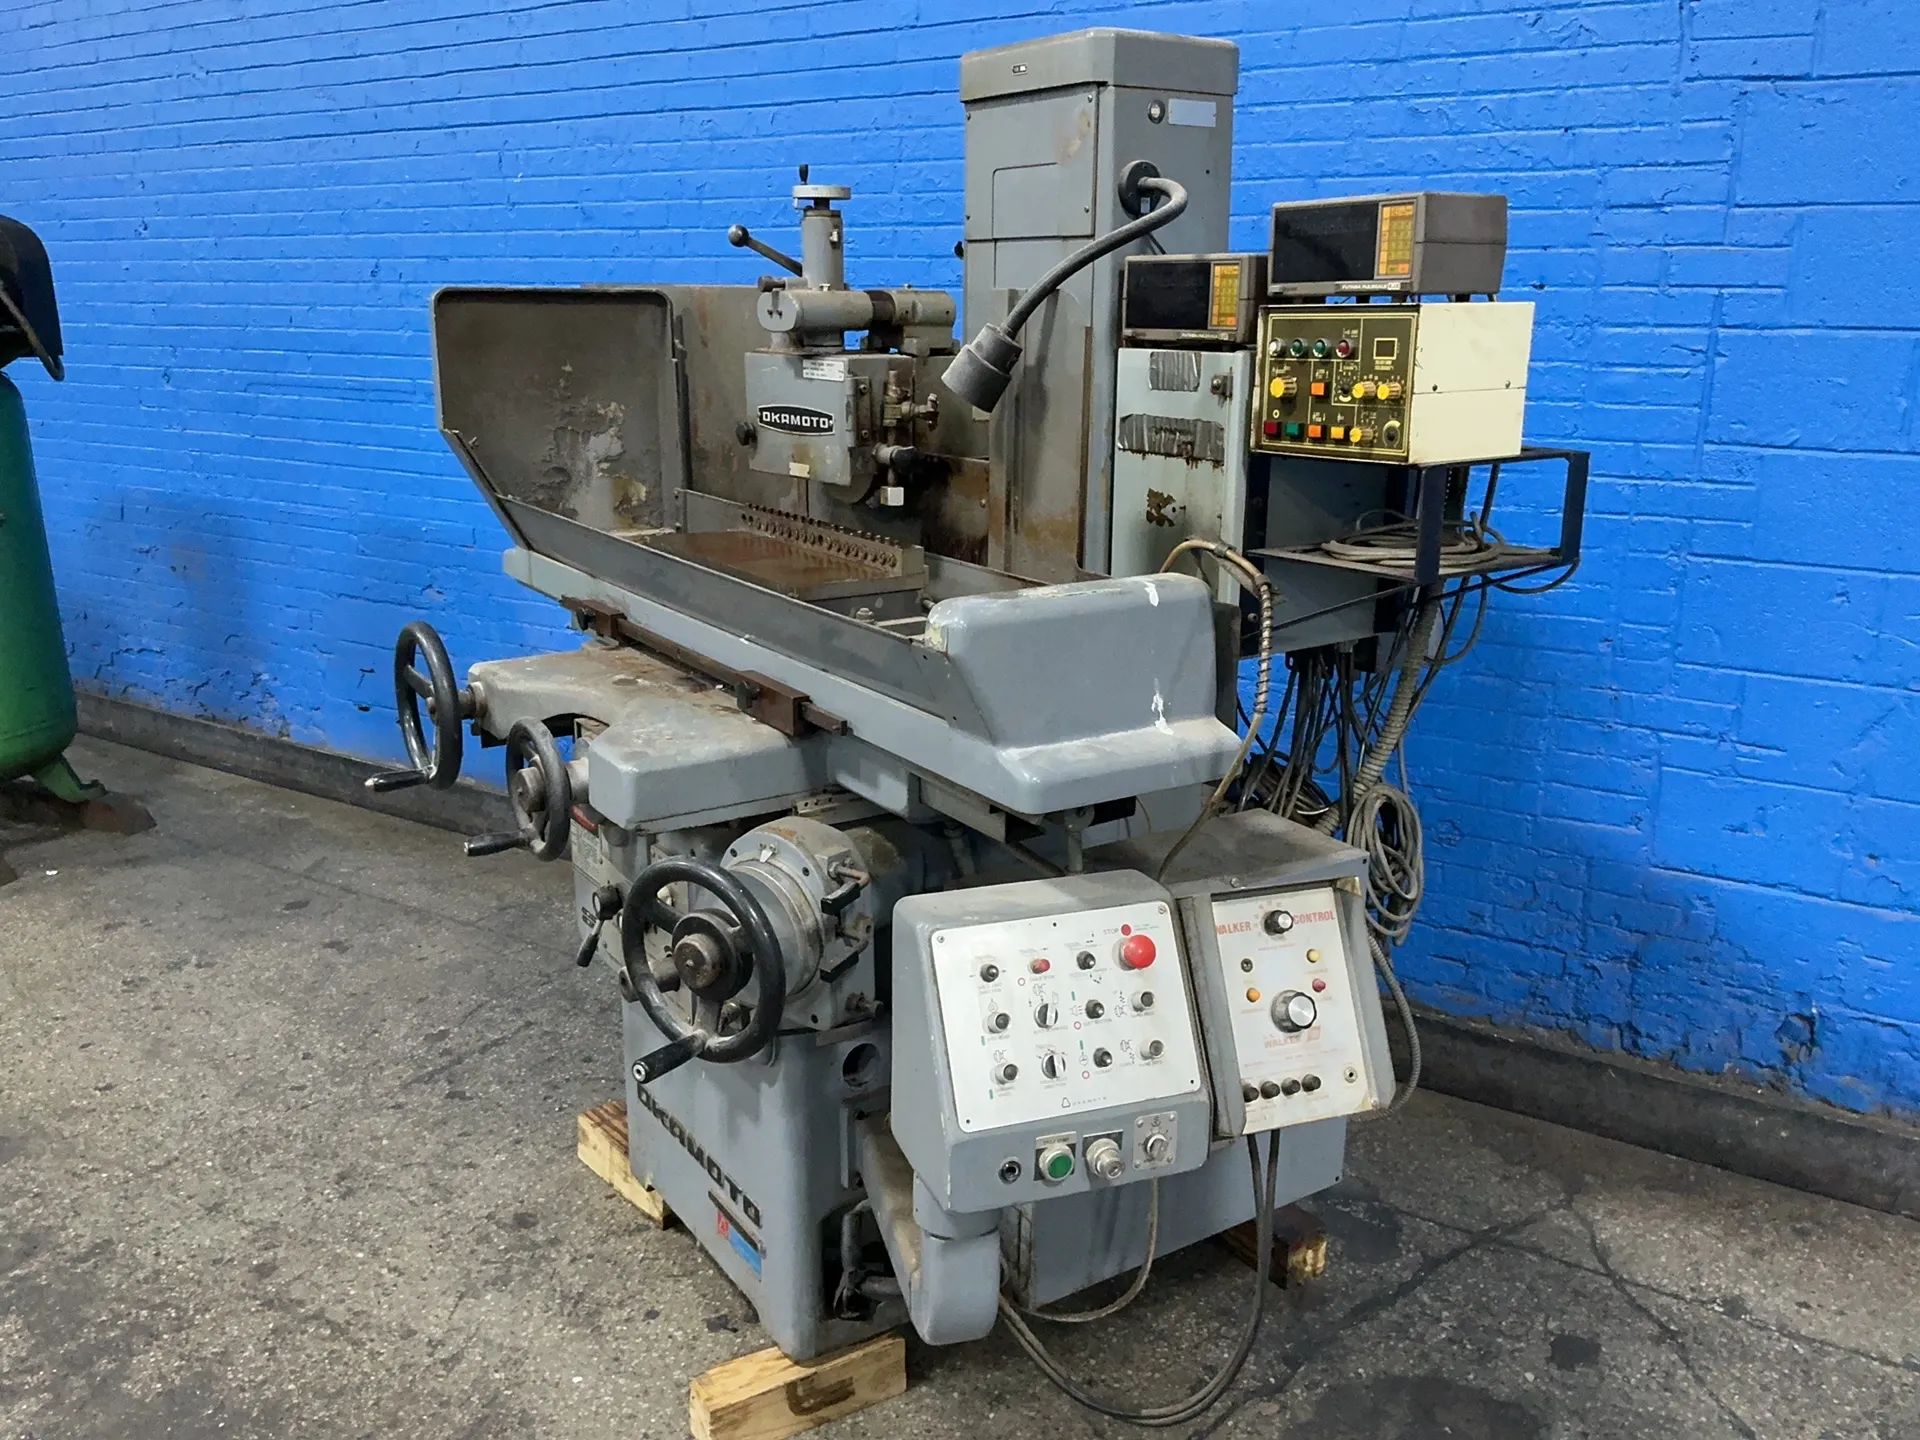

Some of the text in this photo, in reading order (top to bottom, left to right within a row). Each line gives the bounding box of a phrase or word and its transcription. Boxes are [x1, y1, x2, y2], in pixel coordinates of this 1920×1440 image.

[762, 411, 829, 429] OKAMOTO
[1293, 910, 1336, 925] CONTROL
[1103, 927, 1120, 936] STOP
[636, 1082, 763, 1229] OKAMOTO
